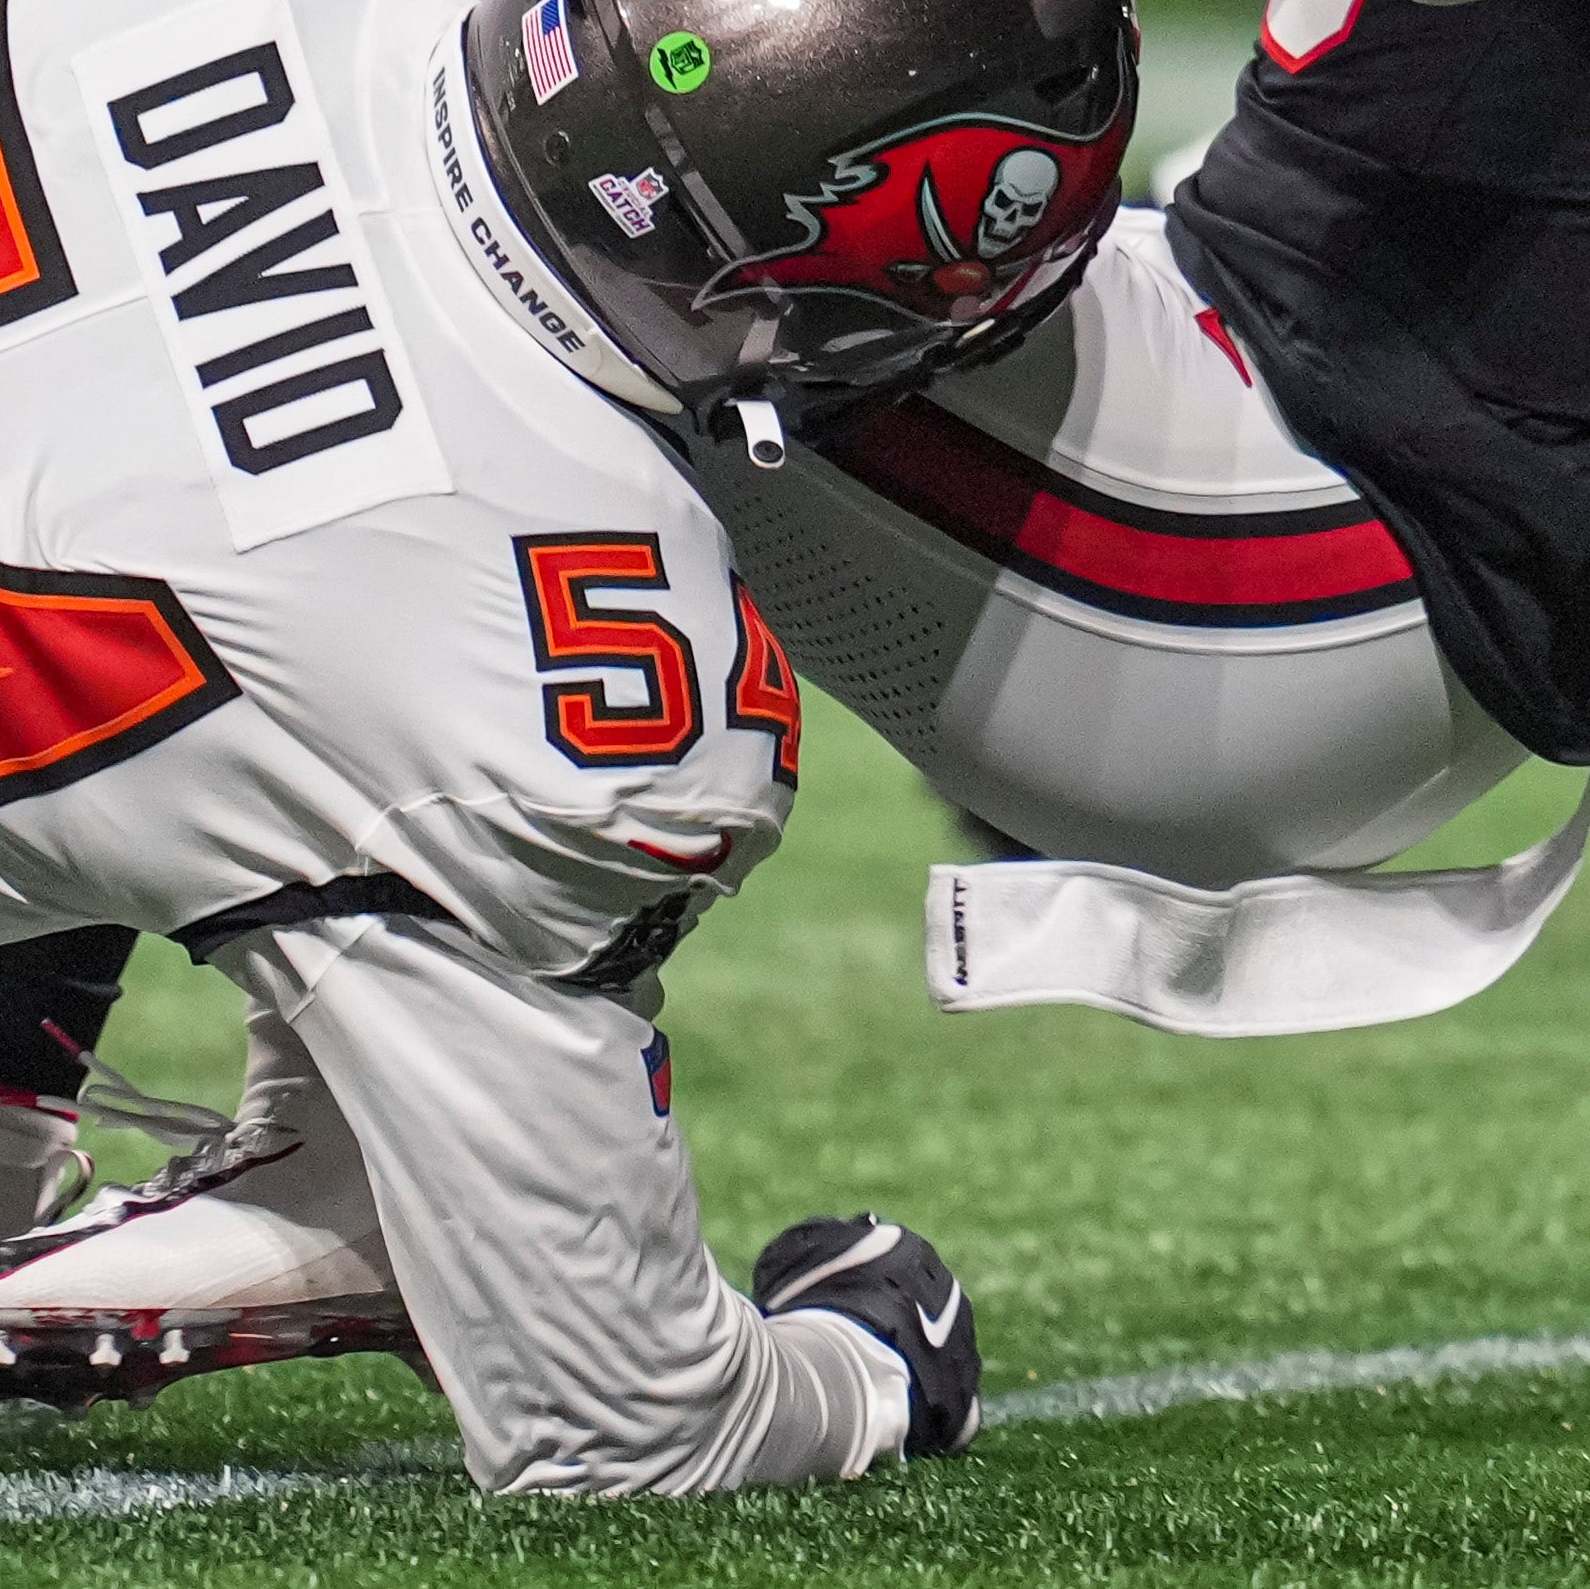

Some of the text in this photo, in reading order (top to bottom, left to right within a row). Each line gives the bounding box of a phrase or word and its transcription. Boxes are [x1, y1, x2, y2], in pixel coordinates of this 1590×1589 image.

[111, 40, 404, 477] DAVID
[433, 66, 586, 353] INSPIRE CHANGE
[599, 178, 651, 232] CATCH
[511, 530, 802, 791] 54
